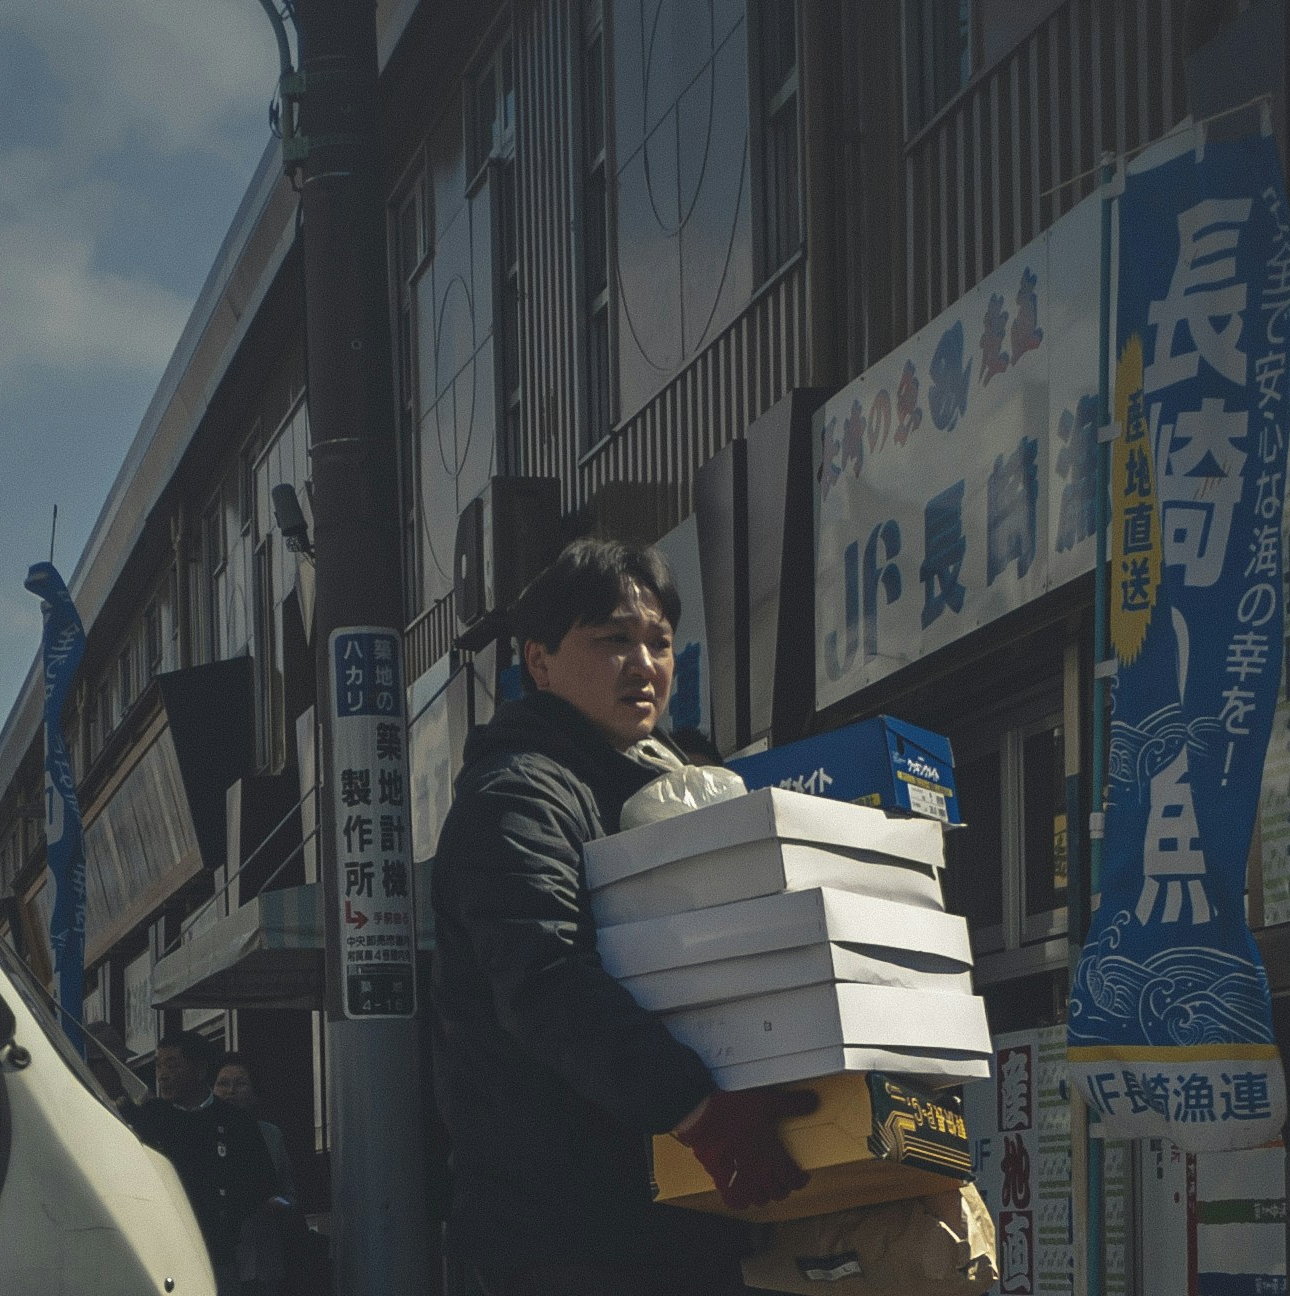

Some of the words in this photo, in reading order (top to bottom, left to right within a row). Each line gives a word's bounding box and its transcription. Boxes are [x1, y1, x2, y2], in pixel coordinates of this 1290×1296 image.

[343, 640, 363, 712] ハカリ
[373, 639, 394, 712] 築地の
[341, 768, 373, 898] 製作所
[376, 722, 407, 898] 築地計機
